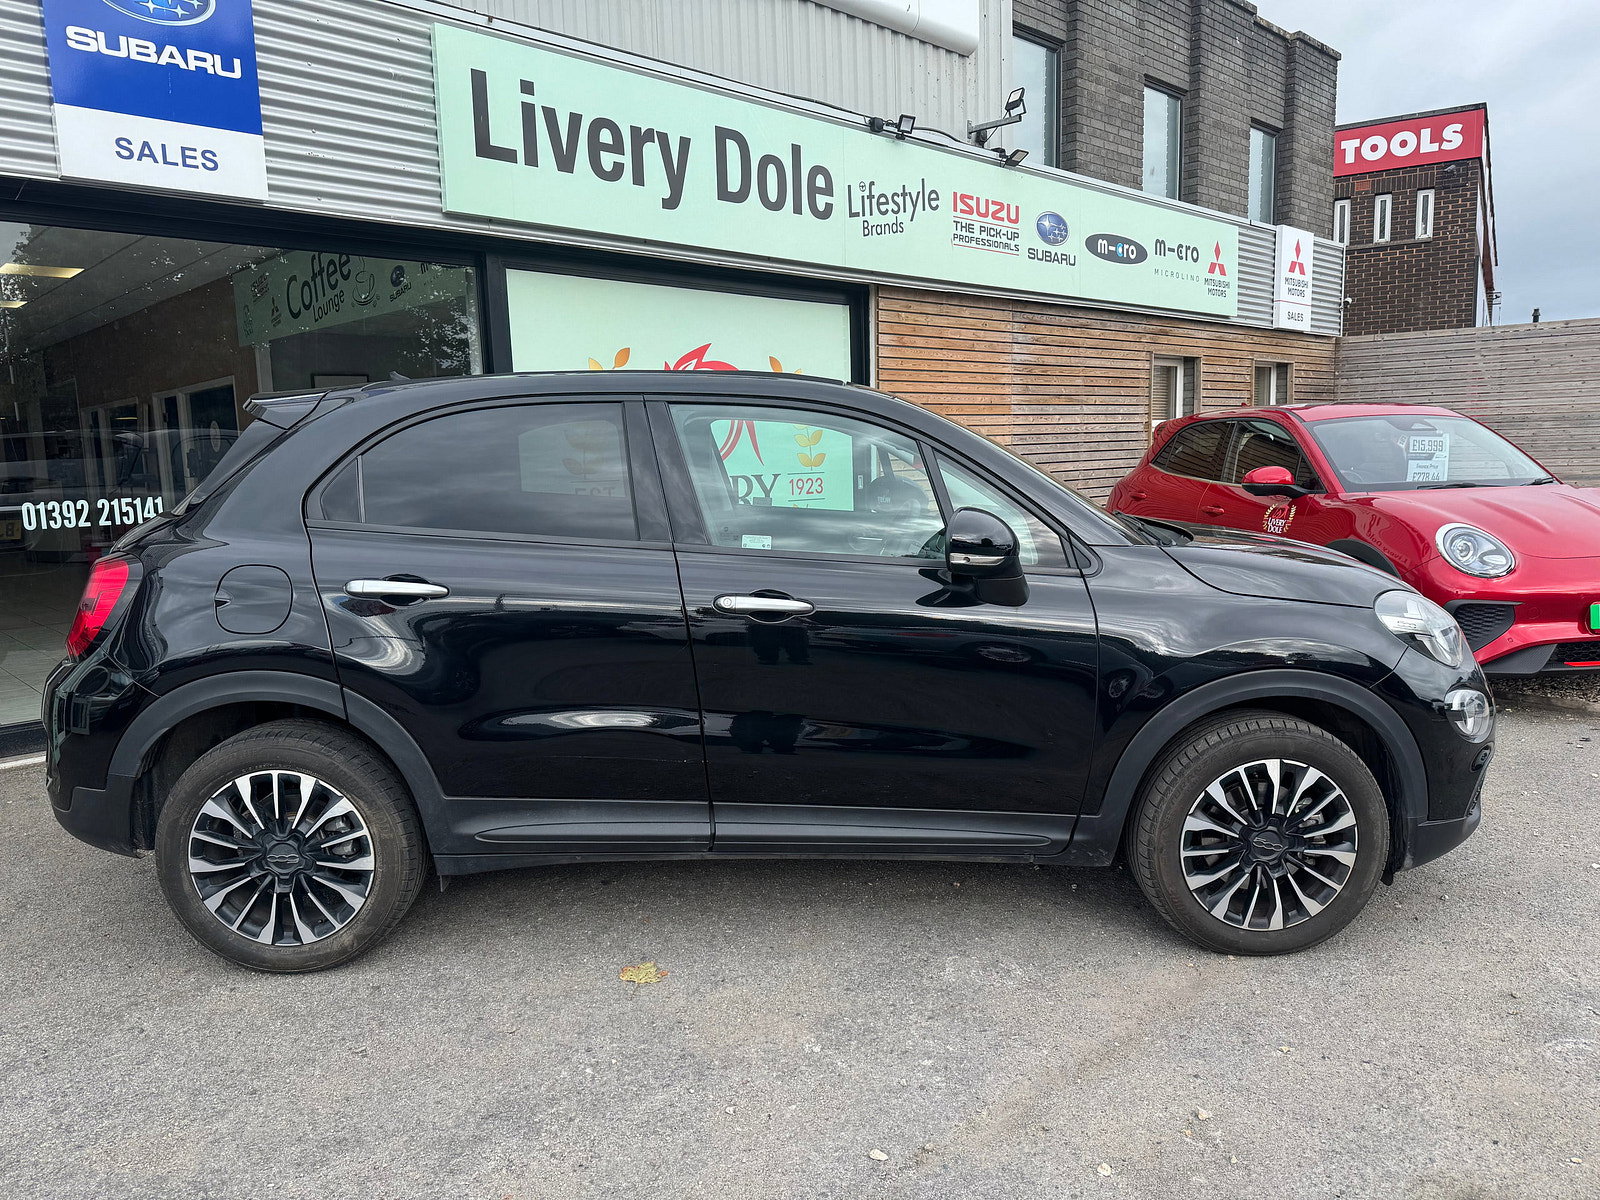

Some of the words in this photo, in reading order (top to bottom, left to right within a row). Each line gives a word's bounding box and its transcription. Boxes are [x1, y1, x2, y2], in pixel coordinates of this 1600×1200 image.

[65, 25, 242, 79] SUBARU
[115, 136, 219, 172] SALES
[471, 68, 691, 210] Livery
[715, 125, 834, 220] Dole
[1340, 123, 1463, 164] TOOLS
[848, 178, 940, 222] Lifestyle
[953, 191, 1020, 225] ISUZU
[862, 216, 904, 237] Brands
[953, 220, 975, 234] THE
[980, 225, 1020, 242] PICK-UP
[953, 233, 1020, 252] PROFESSIONALS
[1028, 247, 1077, 267] SUBARU
[1154, 268, 1200, 282] MICROLINO
[1204, 277, 1231, 289] MITSUBISHI
[1284, 276, 1309, 289] MITSUBISHI
[286, 252, 352, 320] Coffee
[389, 282, 412, 303] SUBARU
[1207, 287, 1227, 298] MOTORS
[1287, 286, 1306, 298] MOTORS
[311, 289, 345, 323] Lounge
[1286, 311, 1304, 322] SALES
[789, 477, 824, 496] 1923
[21, 500, 91, 530] 01392
[97, 497, 164, 524] 215141
